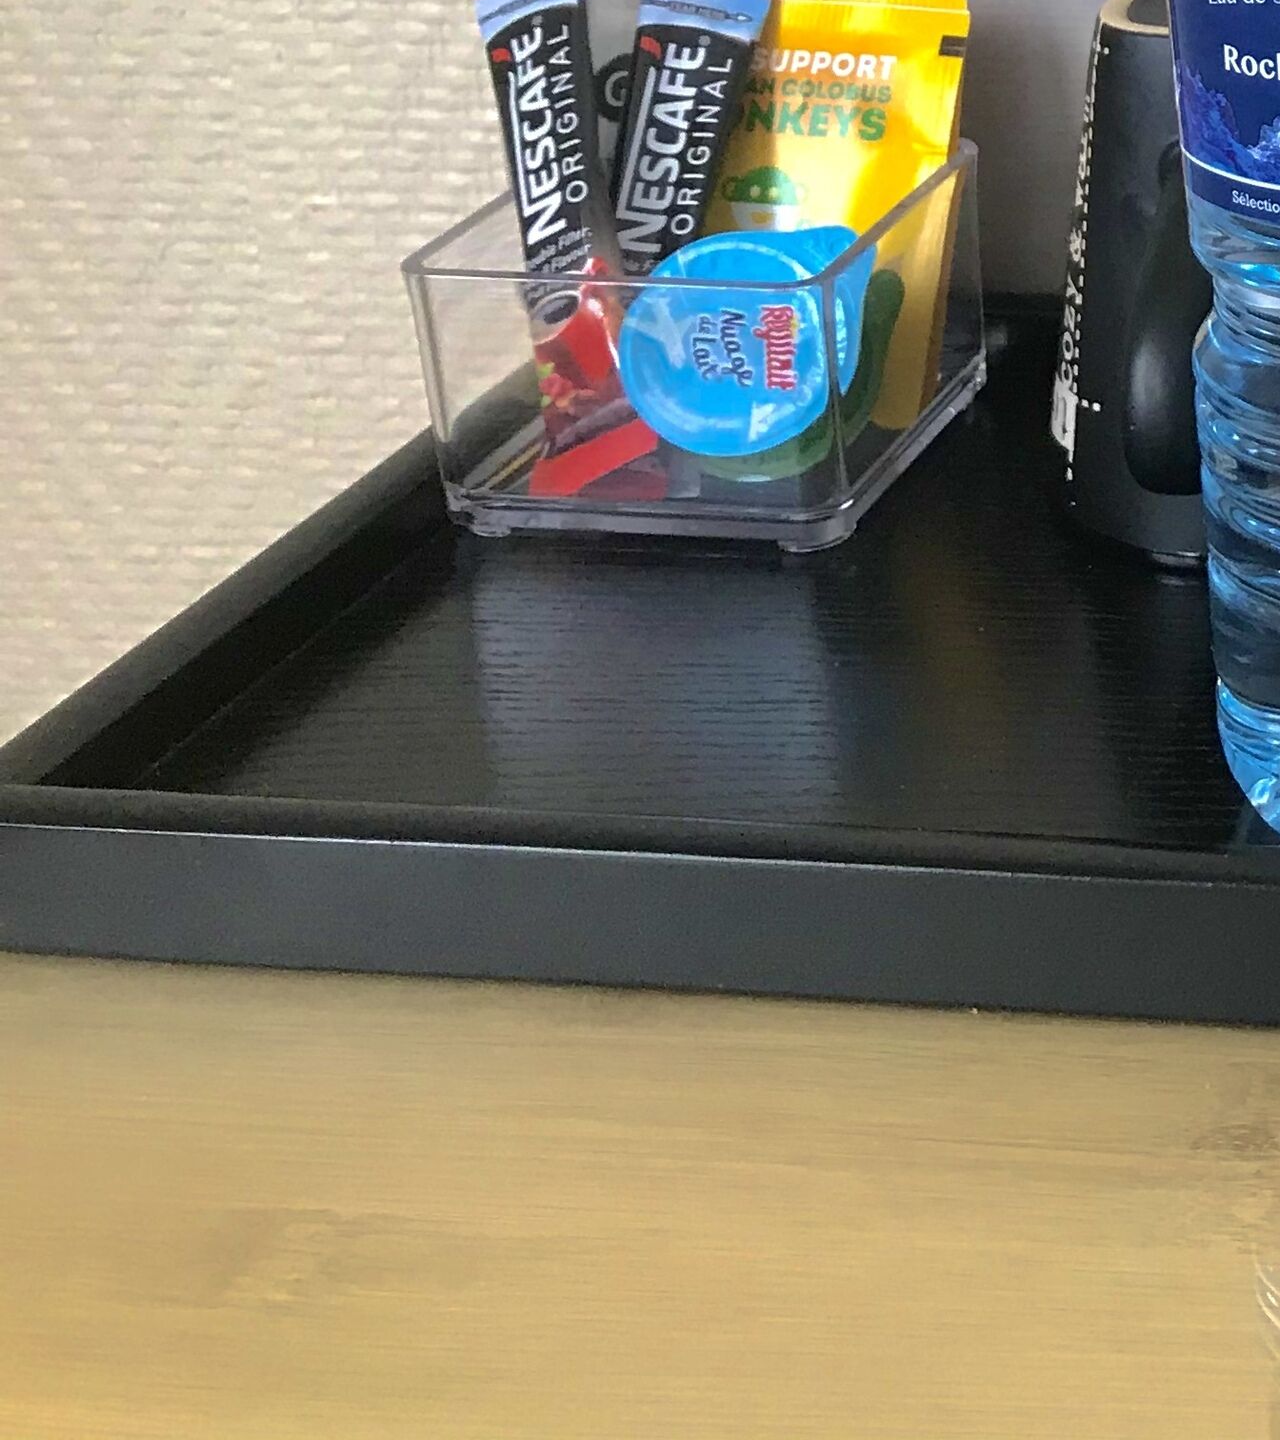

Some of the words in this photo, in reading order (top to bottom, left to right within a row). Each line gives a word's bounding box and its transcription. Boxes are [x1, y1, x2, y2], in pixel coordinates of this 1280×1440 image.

[750, 49, 898, 81] SUPPORT
[781, 78, 893, 104] COLOBUS
[546, 23, 589, 204] ORIGINAL
[744, 100, 887, 141] NKEYS
[669, 57, 734, 236] ORIGINAL
[698, 314, 718, 335] de
[718, 308, 754, 388] Nuage
